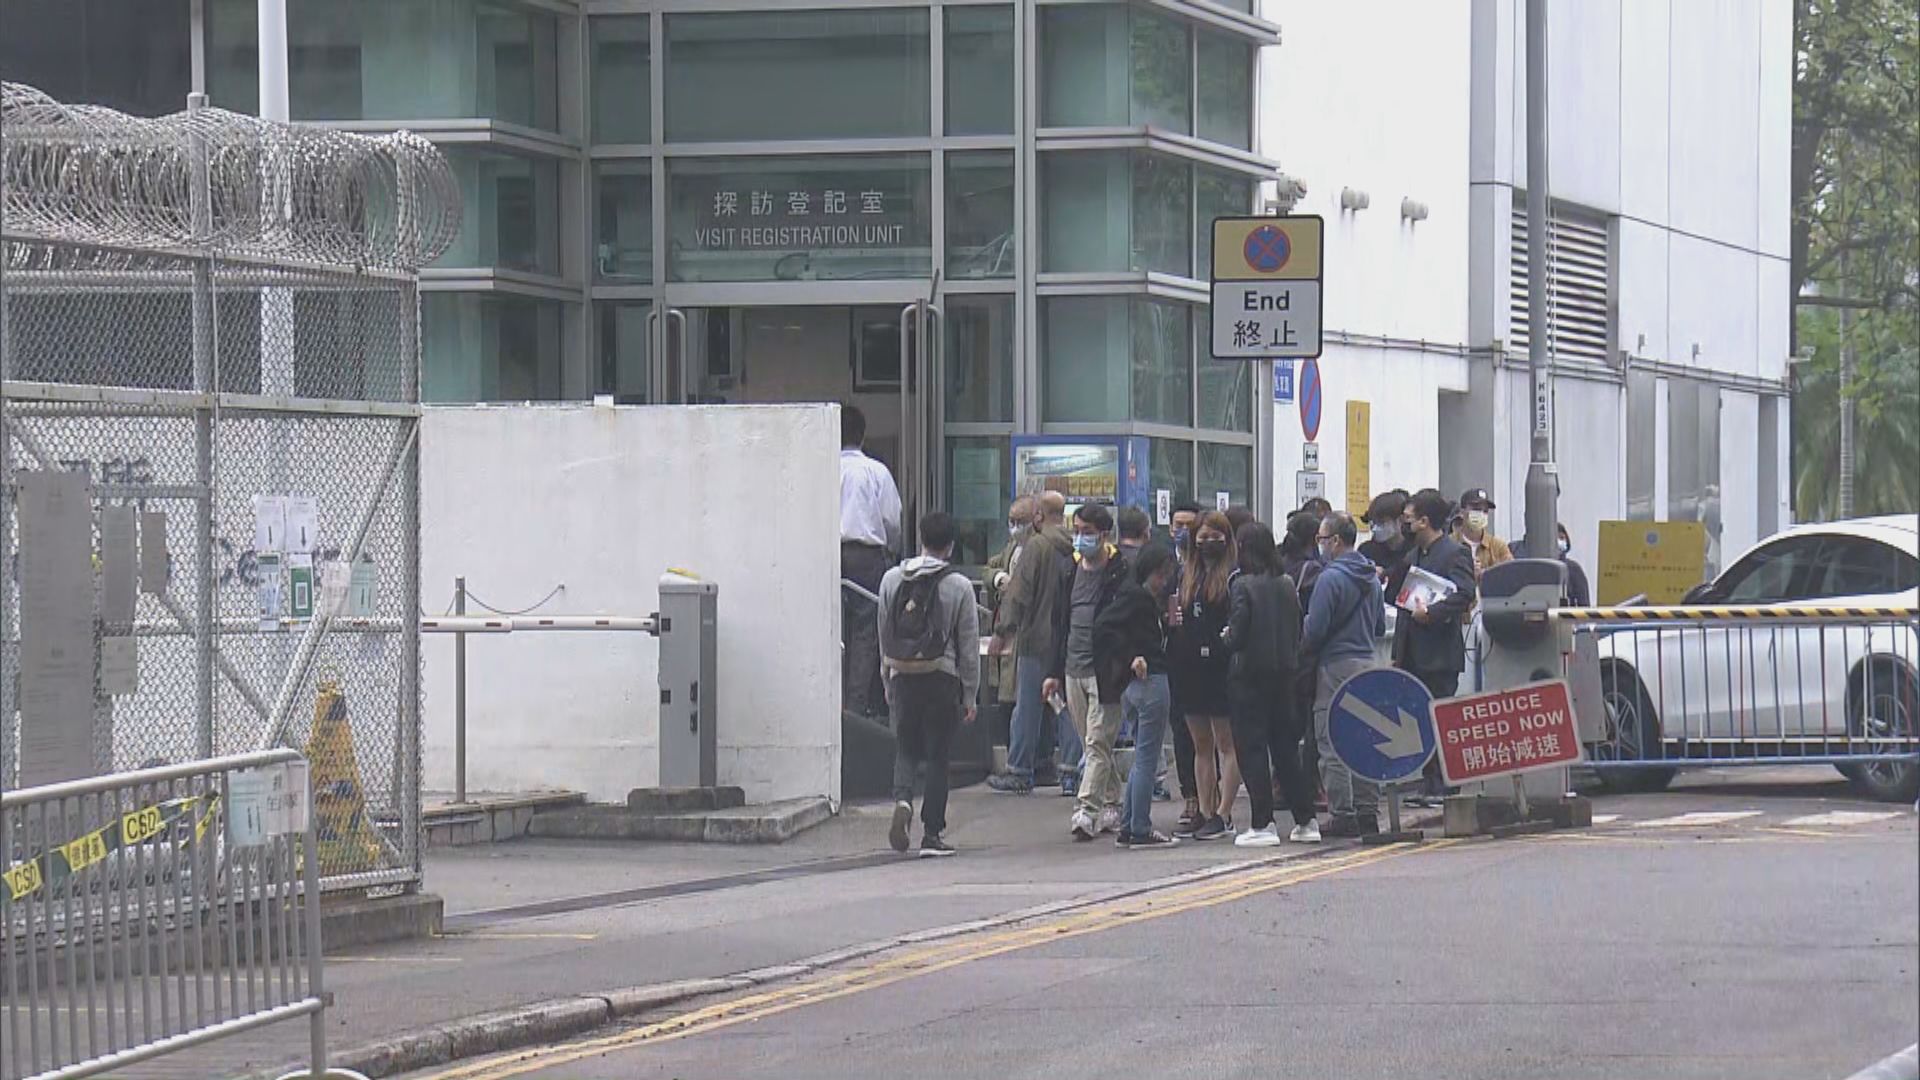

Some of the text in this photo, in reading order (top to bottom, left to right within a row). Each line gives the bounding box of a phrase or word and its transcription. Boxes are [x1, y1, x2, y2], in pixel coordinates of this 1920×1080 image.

[713, 190, 884, 217] 探訪登記室
[696, 225, 904, 246] VISIT REGISTRATION UNIT
[1244, 290, 1290, 311] End
[1232, 319, 1298, 348] 終止
[1462, 693, 1542, 722] REDUCE
[1446, 709, 1564, 744] SPEED NOW
[1463, 733, 1561, 770] 開始減速
[126, 811, 157, 839] CSD
[14, 864, 37, 893] CSD
